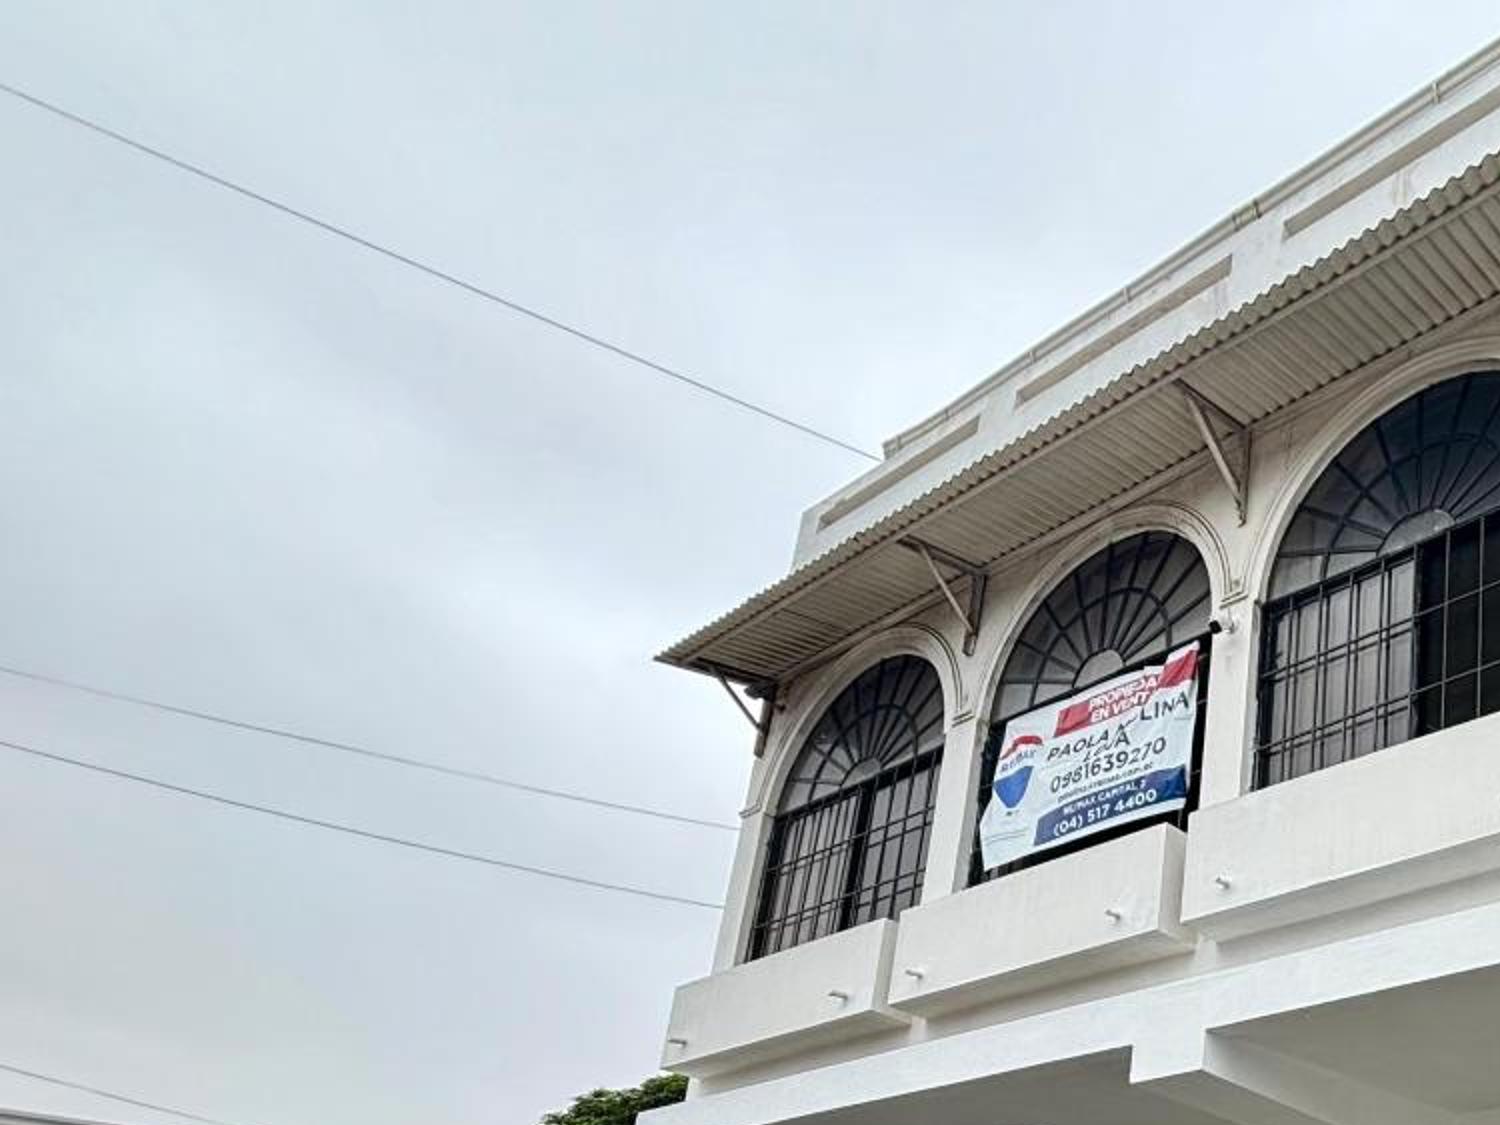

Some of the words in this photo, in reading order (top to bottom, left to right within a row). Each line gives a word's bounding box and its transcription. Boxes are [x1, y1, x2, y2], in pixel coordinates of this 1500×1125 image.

[1091, 704, 1110, 723] EN
[1047, 729, 1110, 761] PAOLA
[1097, 781, 1138, 802] CAPITAL
[1053, 813, 1083, 836] (04)
[1087, 803, 1111, 823] 517
[1114, 788, 1157, 812] 4400
